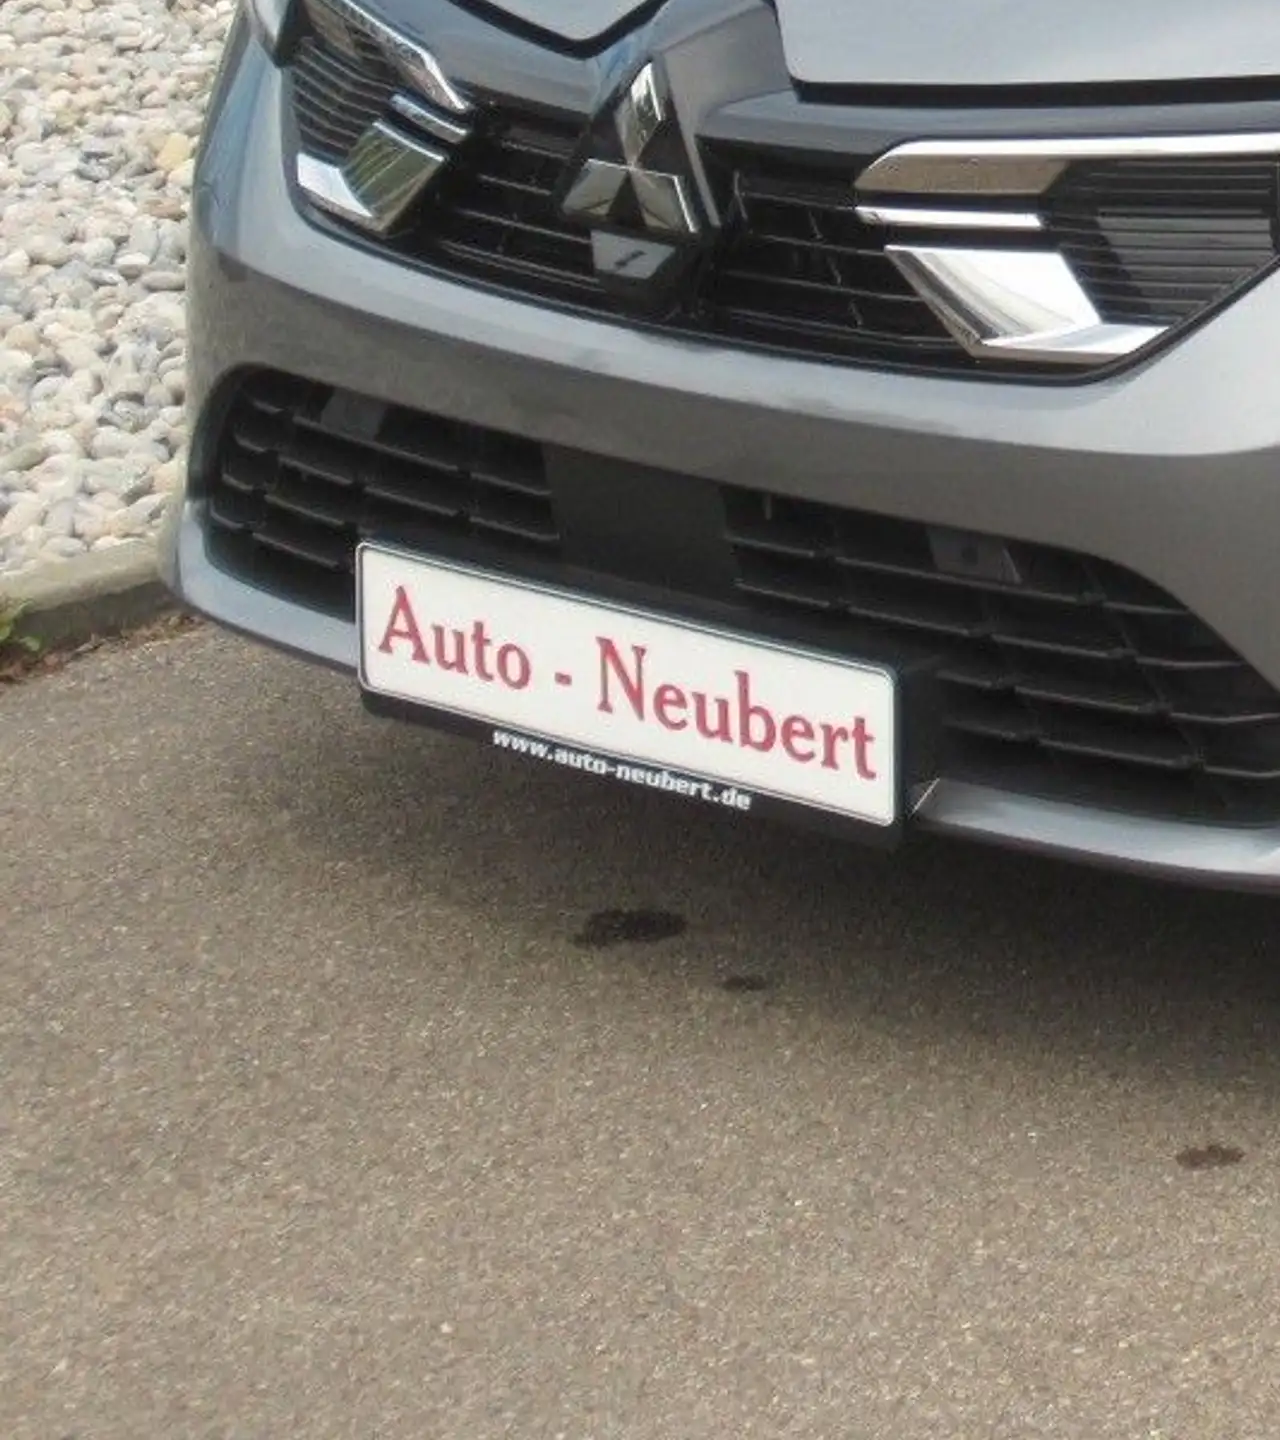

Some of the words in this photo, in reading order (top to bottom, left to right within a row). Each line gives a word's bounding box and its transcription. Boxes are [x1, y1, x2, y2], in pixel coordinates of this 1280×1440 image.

[378, 585, 532, 690] Auto
[596, 636, 877, 780] Neubert
[493, 728, 752, 811] www.auto-neubert.de
